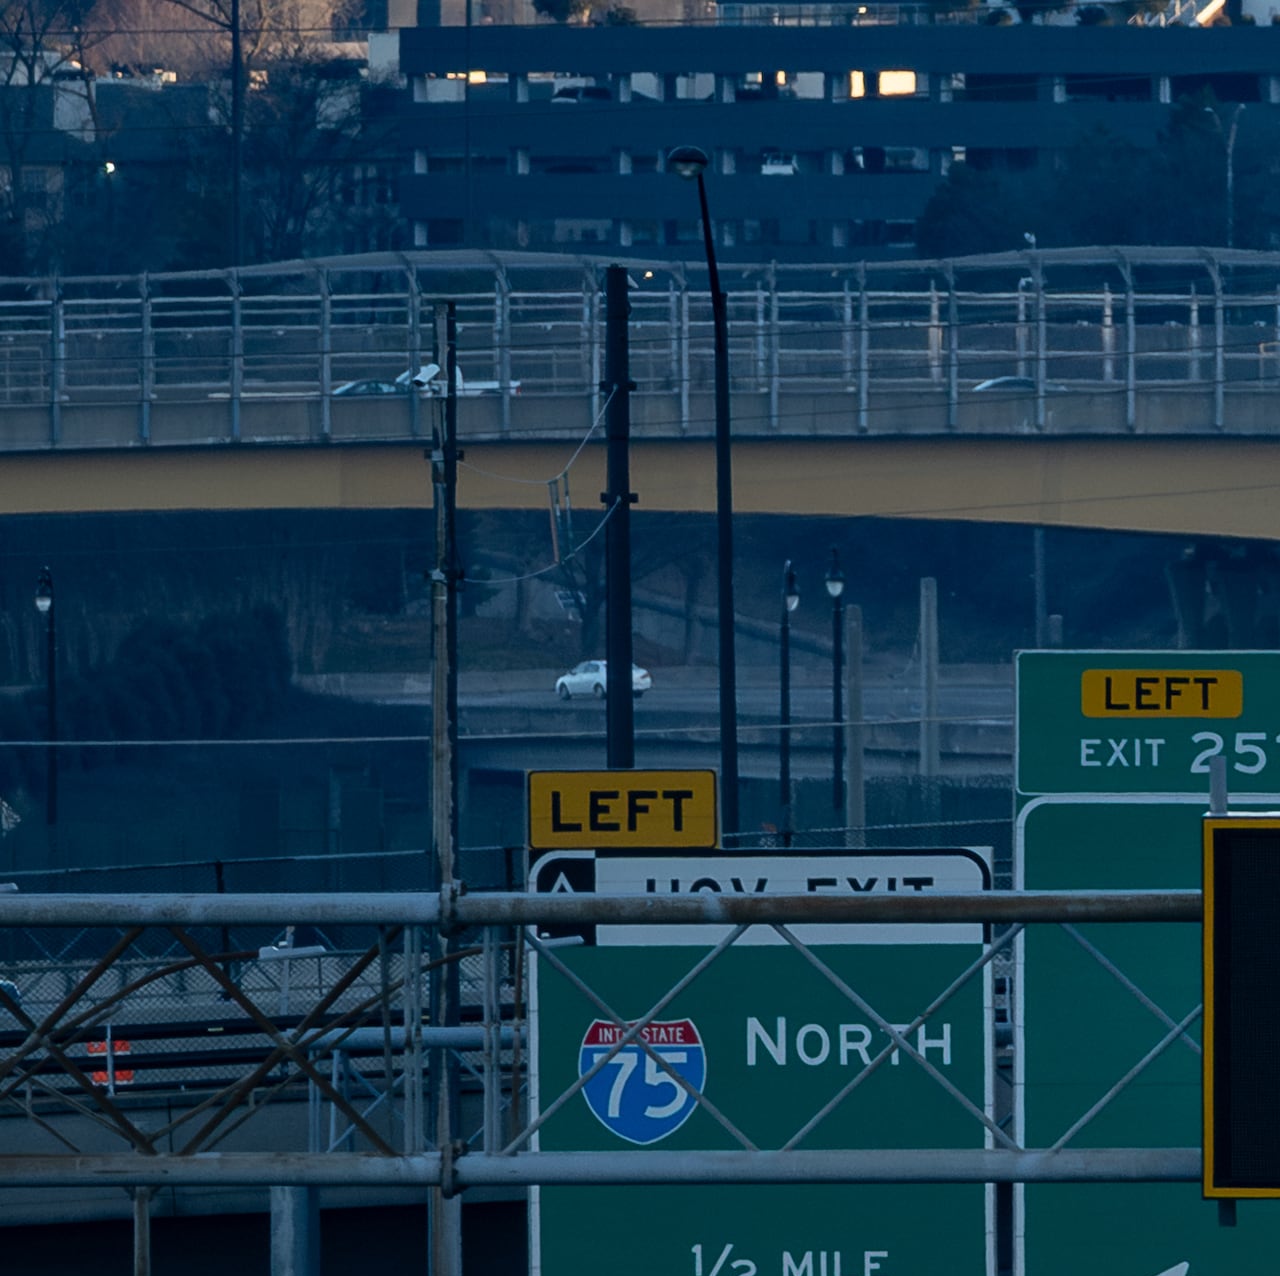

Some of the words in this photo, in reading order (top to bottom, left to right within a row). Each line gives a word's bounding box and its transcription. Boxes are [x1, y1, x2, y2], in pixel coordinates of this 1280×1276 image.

[1105, 677, 1217, 710] LEFT
[1081, 739, 1165, 766] EXIT
[552, 790, 693, 832] LEFT
[599, 1027, 685, 1043] INTSTATE
[746, 1016, 951, 1066] NORTH
[592, 1052, 689, 1119] 75
